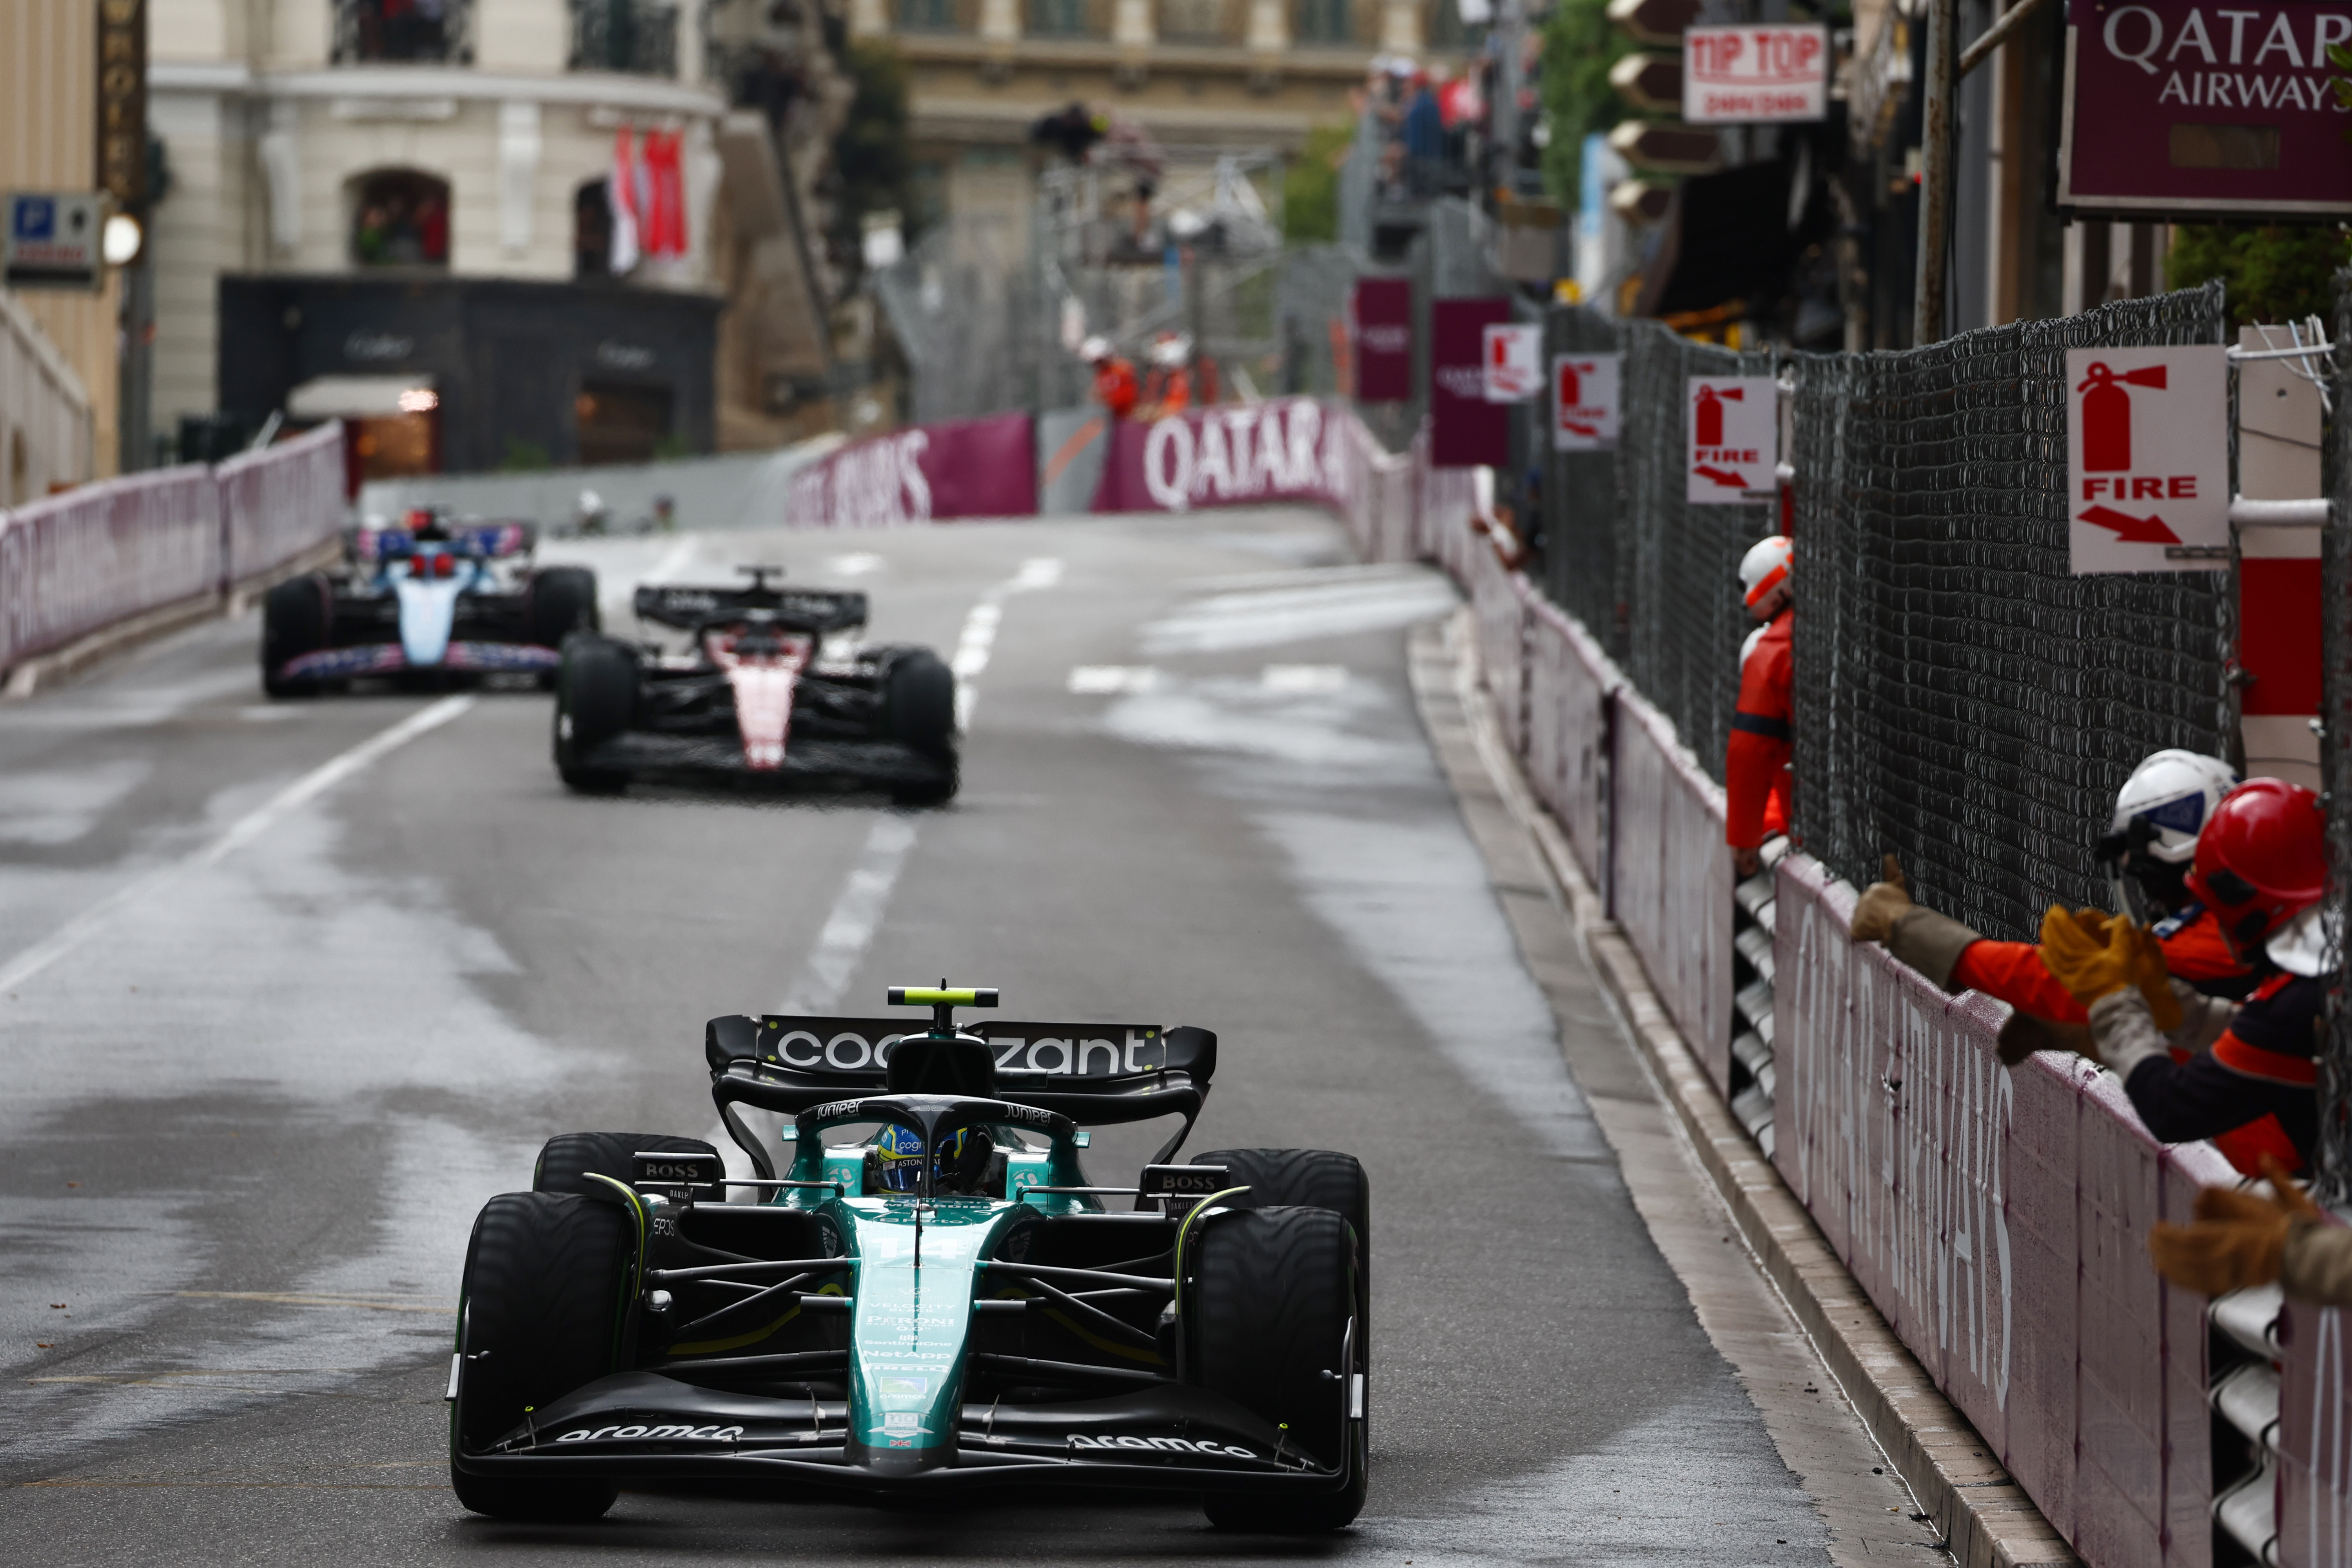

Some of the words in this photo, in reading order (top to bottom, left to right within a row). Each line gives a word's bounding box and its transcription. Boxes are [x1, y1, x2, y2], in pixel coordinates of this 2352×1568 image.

[2103, 5, 2352, 75] QATAR
[1691, 33, 1744, 72] TIP
[1754, 31, 1821, 75] TOP
[2158, 70, 2352, 113] AIRWAY
[1695, 448, 1759, 464] FIRE
[2082, 475, 2198, 501] FIRE
[777, 1029, 1145, 1075] cozant
[647, 1163, 698, 1178] BOSS
[898, 1158, 922, 1167] ASTON
[1163, 1176, 1215, 1190] BOSS
[654, 1218, 674, 1237] EPOS
[871, 1236, 966, 1259] 14
[867, 1316, 955, 1325] PERONI
[862, 1350, 951, 1359] NetApp
[556, 1425, 744, 1441] aramco
[1067, 1434, 1257, 1458] aramco
